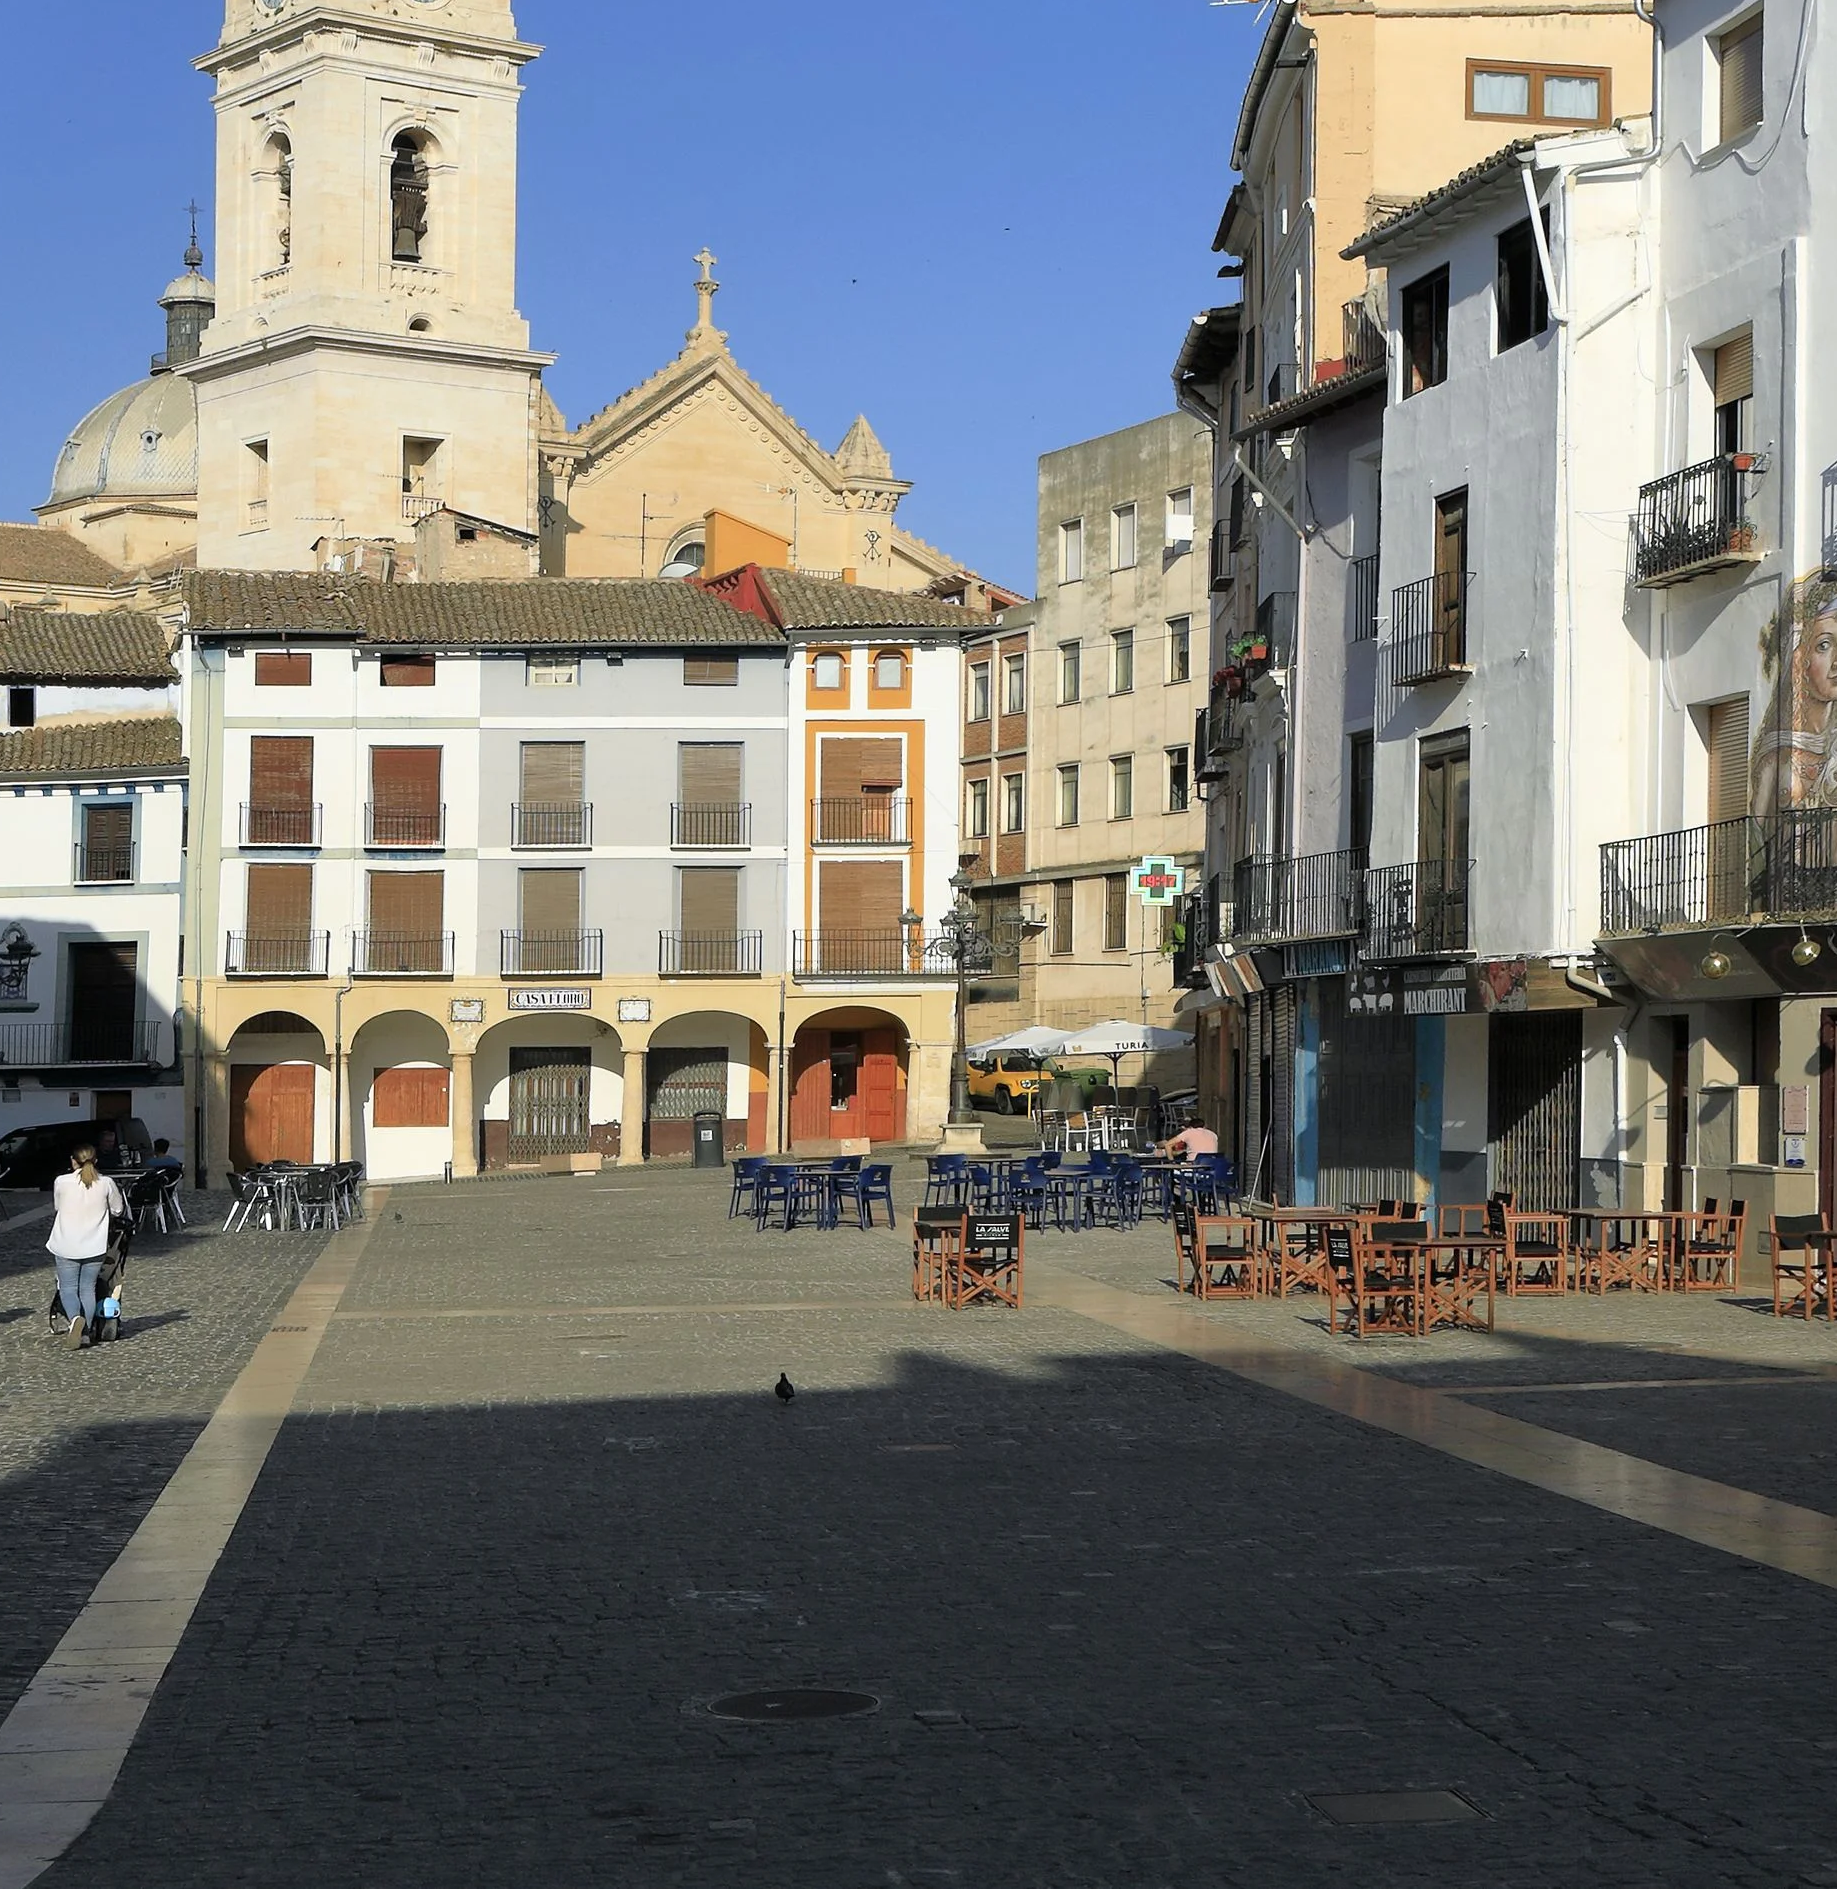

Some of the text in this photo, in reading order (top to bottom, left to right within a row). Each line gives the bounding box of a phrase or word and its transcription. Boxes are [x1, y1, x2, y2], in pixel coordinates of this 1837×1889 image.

[1283, 945, 1297, 977] LA
[516, 993, 546, 1005] CASA
[1403, 987, 1467, 1015] MARCHIRANT
[1114, 1041, 1150, 1051] TURIA
